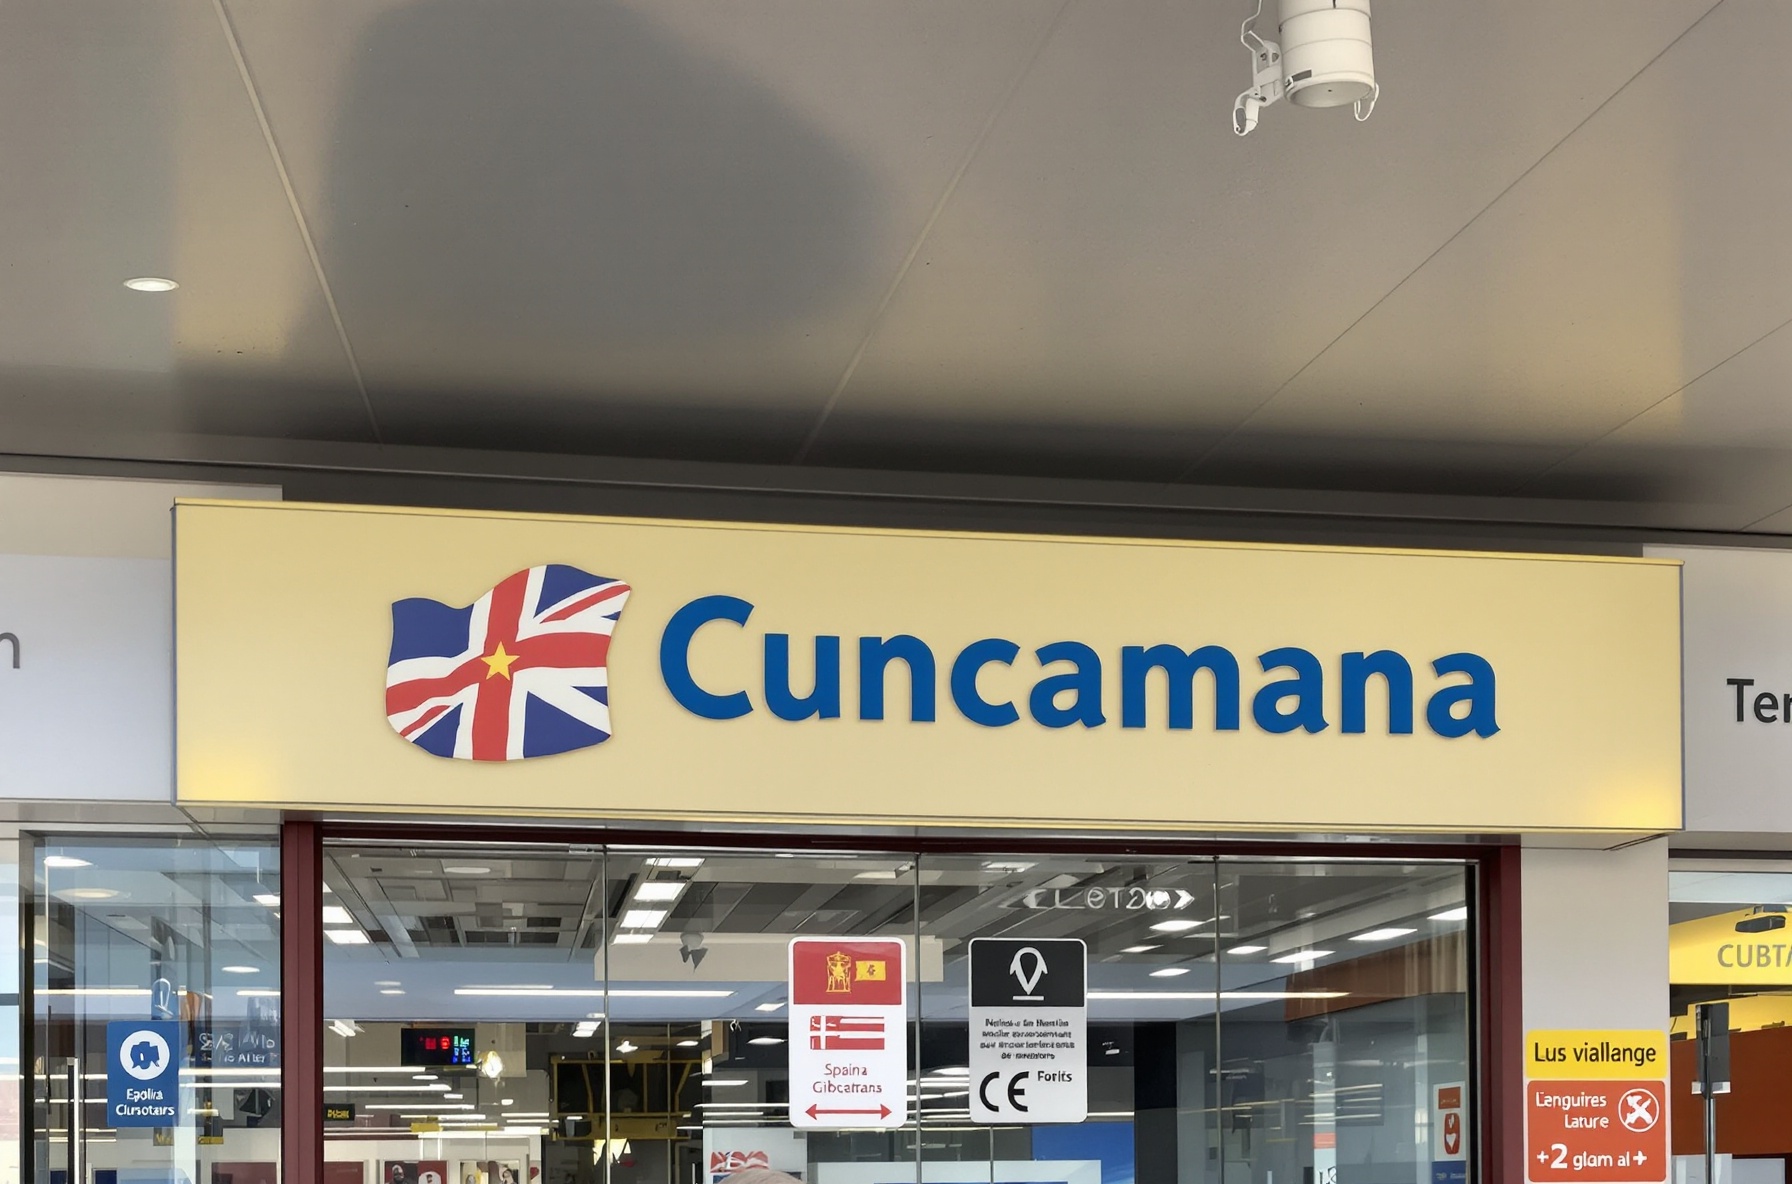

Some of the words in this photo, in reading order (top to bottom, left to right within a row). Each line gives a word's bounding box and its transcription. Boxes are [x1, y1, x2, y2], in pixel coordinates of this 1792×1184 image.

[660, 595, 1499, 738] Cuncamana
[1534, 1042, 1567, 1062] Lus
[1573, 1041, 1657, 1067] viallange
[979, 1071, 1030, 1113] CE
